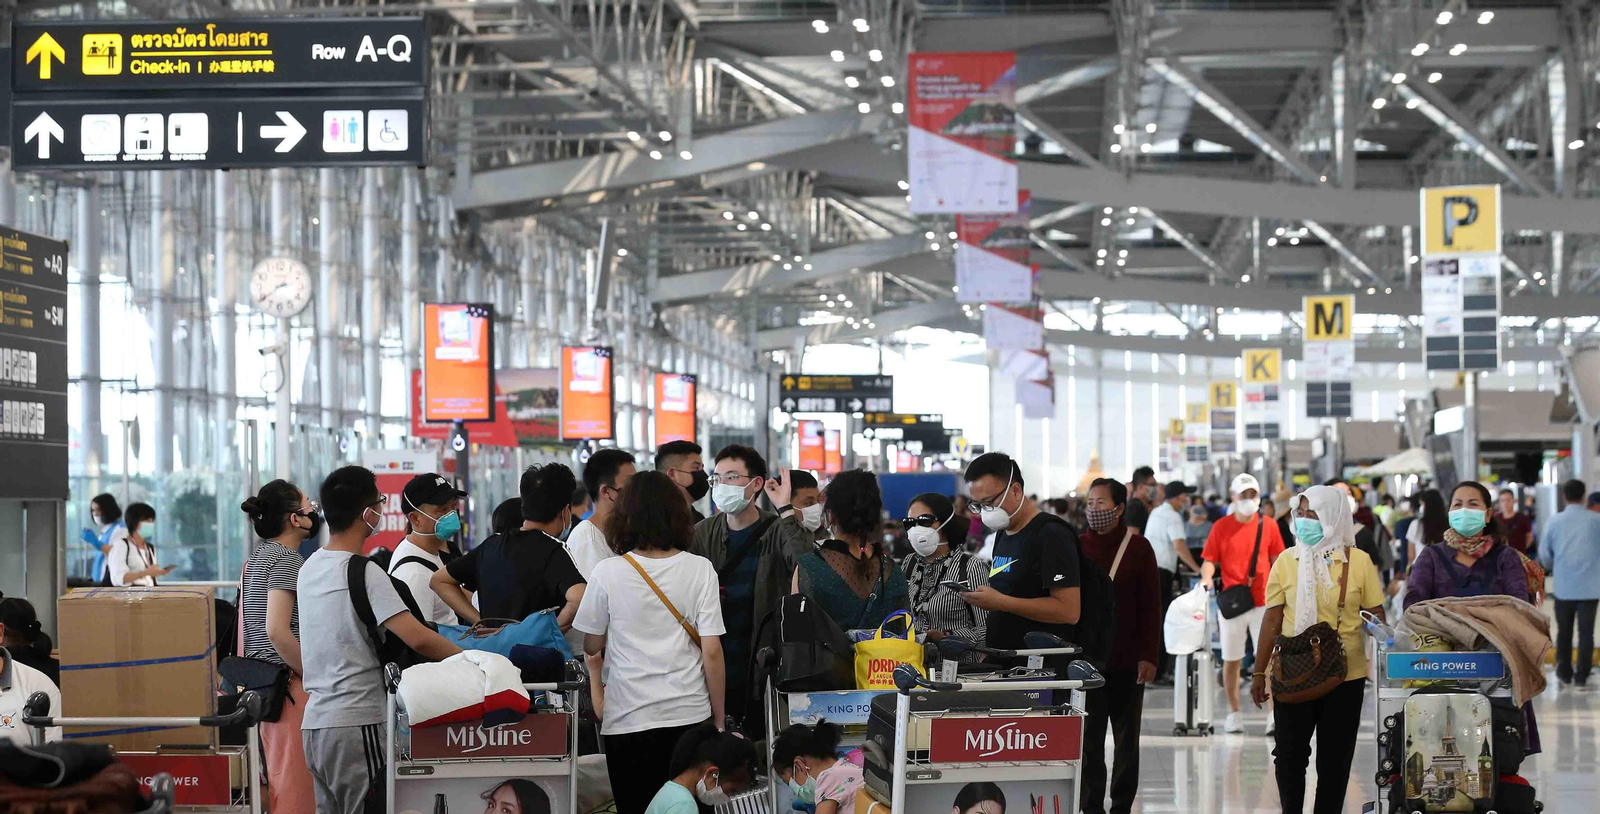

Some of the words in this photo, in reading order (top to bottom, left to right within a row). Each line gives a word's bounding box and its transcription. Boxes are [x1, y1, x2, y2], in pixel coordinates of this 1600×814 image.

[130, 23, 269, 49] ตรวจบัตรโดยสาร
[311, 43, 346, 60] Row
[354, 34, 412, 63] A-Q
[130, 59, 191, 74] Check-in
[1442, 195, 1479, 247] P
[51, 253, 63, 276] A-Q
[51, 305, 64, 327] S-W
[1313, 301, 1344, 335] M
[1251, 353, 1271, 378] K
[1215, 383, 1231, 406] H
[867, 658, 911, 680] JORD
[1413, 662, 1440, 671] KING
[1442, 662, 1477, 671] POWER
[827, 704, 854, 714] KING
[136, 776, 154, 786] NG
[172, 776, 199, 786] WER
